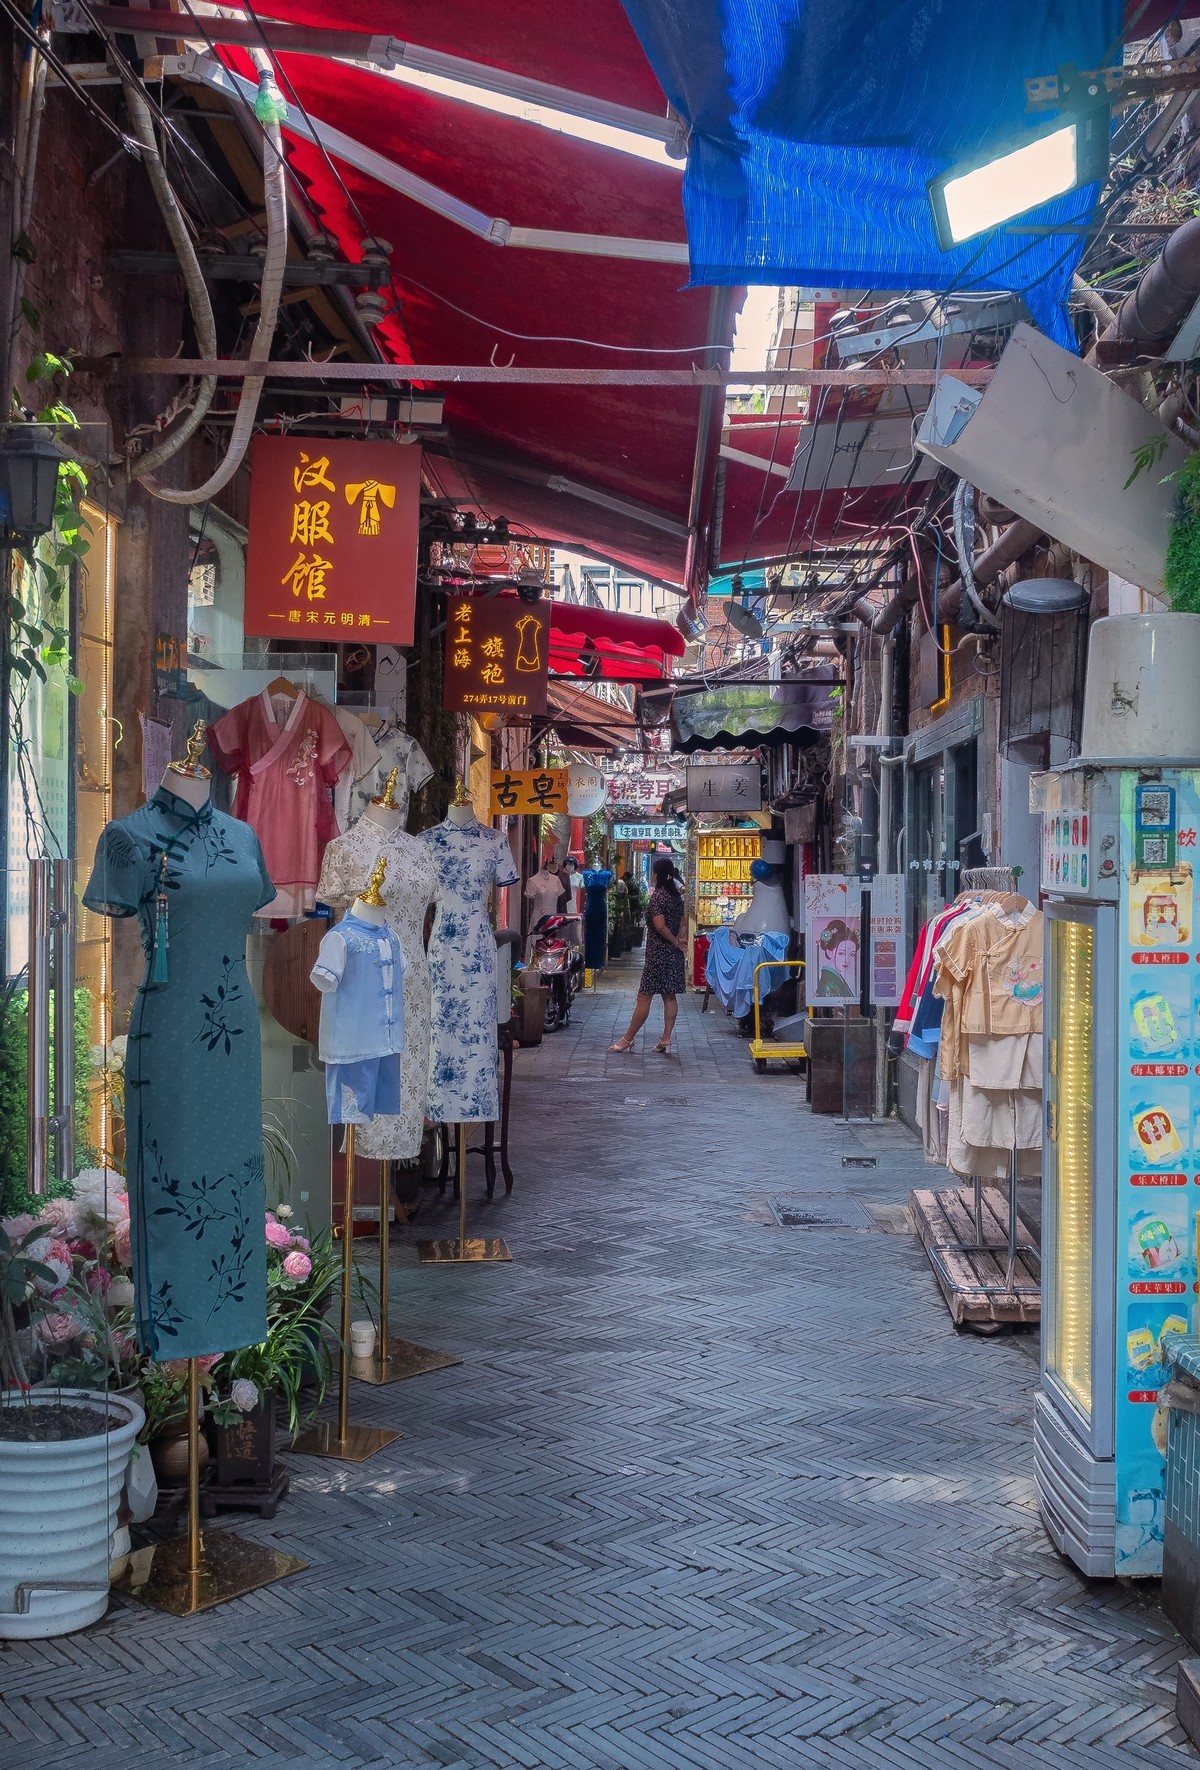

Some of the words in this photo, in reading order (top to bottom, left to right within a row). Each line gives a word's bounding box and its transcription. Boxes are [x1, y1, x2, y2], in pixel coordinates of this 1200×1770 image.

[281, 452, 336, 601] 汉服馆
[288, 610, 371, 627] 唐宋元明清
[454, 604, 472, 668] 老上海
[481, 636, 505, 684] 旗袍
[463, 694, 527, 706] 274弄17号前门
[556, 772, 565, 789] 工坊
[700, 779, 750, 797] 生姜
[491, 773, 562, 809] 古皂
[1177, 828, 1197, 847] 饮
[909, 858, 960, 871] 内有空调
[1139, 953, 1180, 963] 海太橙汁
[1133, 1065, 1186, 1075] 海太椰果粒
[1138, 1175, 1180, 1185] 乐天橙汁
[1132, 1284, 1184, 1294] 乐天苹果汁
